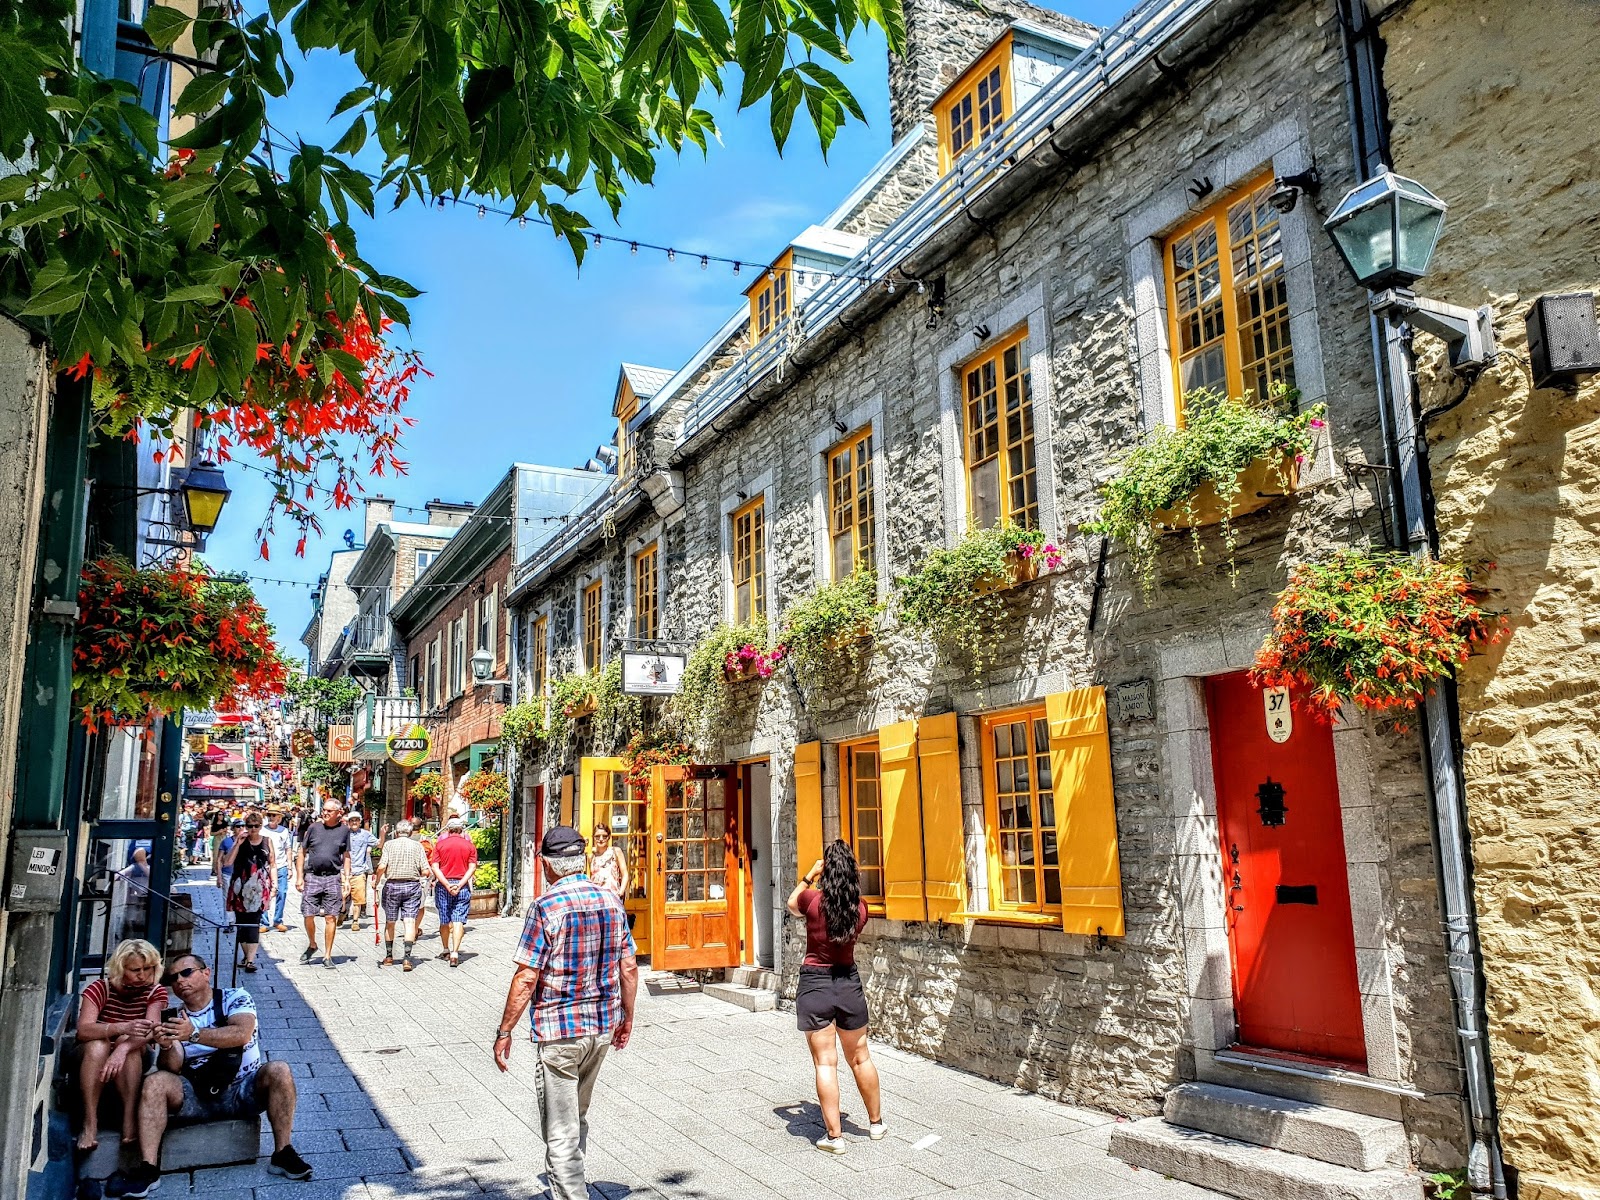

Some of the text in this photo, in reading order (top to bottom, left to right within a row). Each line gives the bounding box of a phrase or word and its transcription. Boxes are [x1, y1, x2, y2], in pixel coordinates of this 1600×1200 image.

[1122, 692, 1145, 701] MAISON
[1268, 693, 1285, 711] 37
[393, 739, 424, 749] ZAZOU
[32, 850, 45, 859] LED
[28, 863, 57, 874] MINORS
